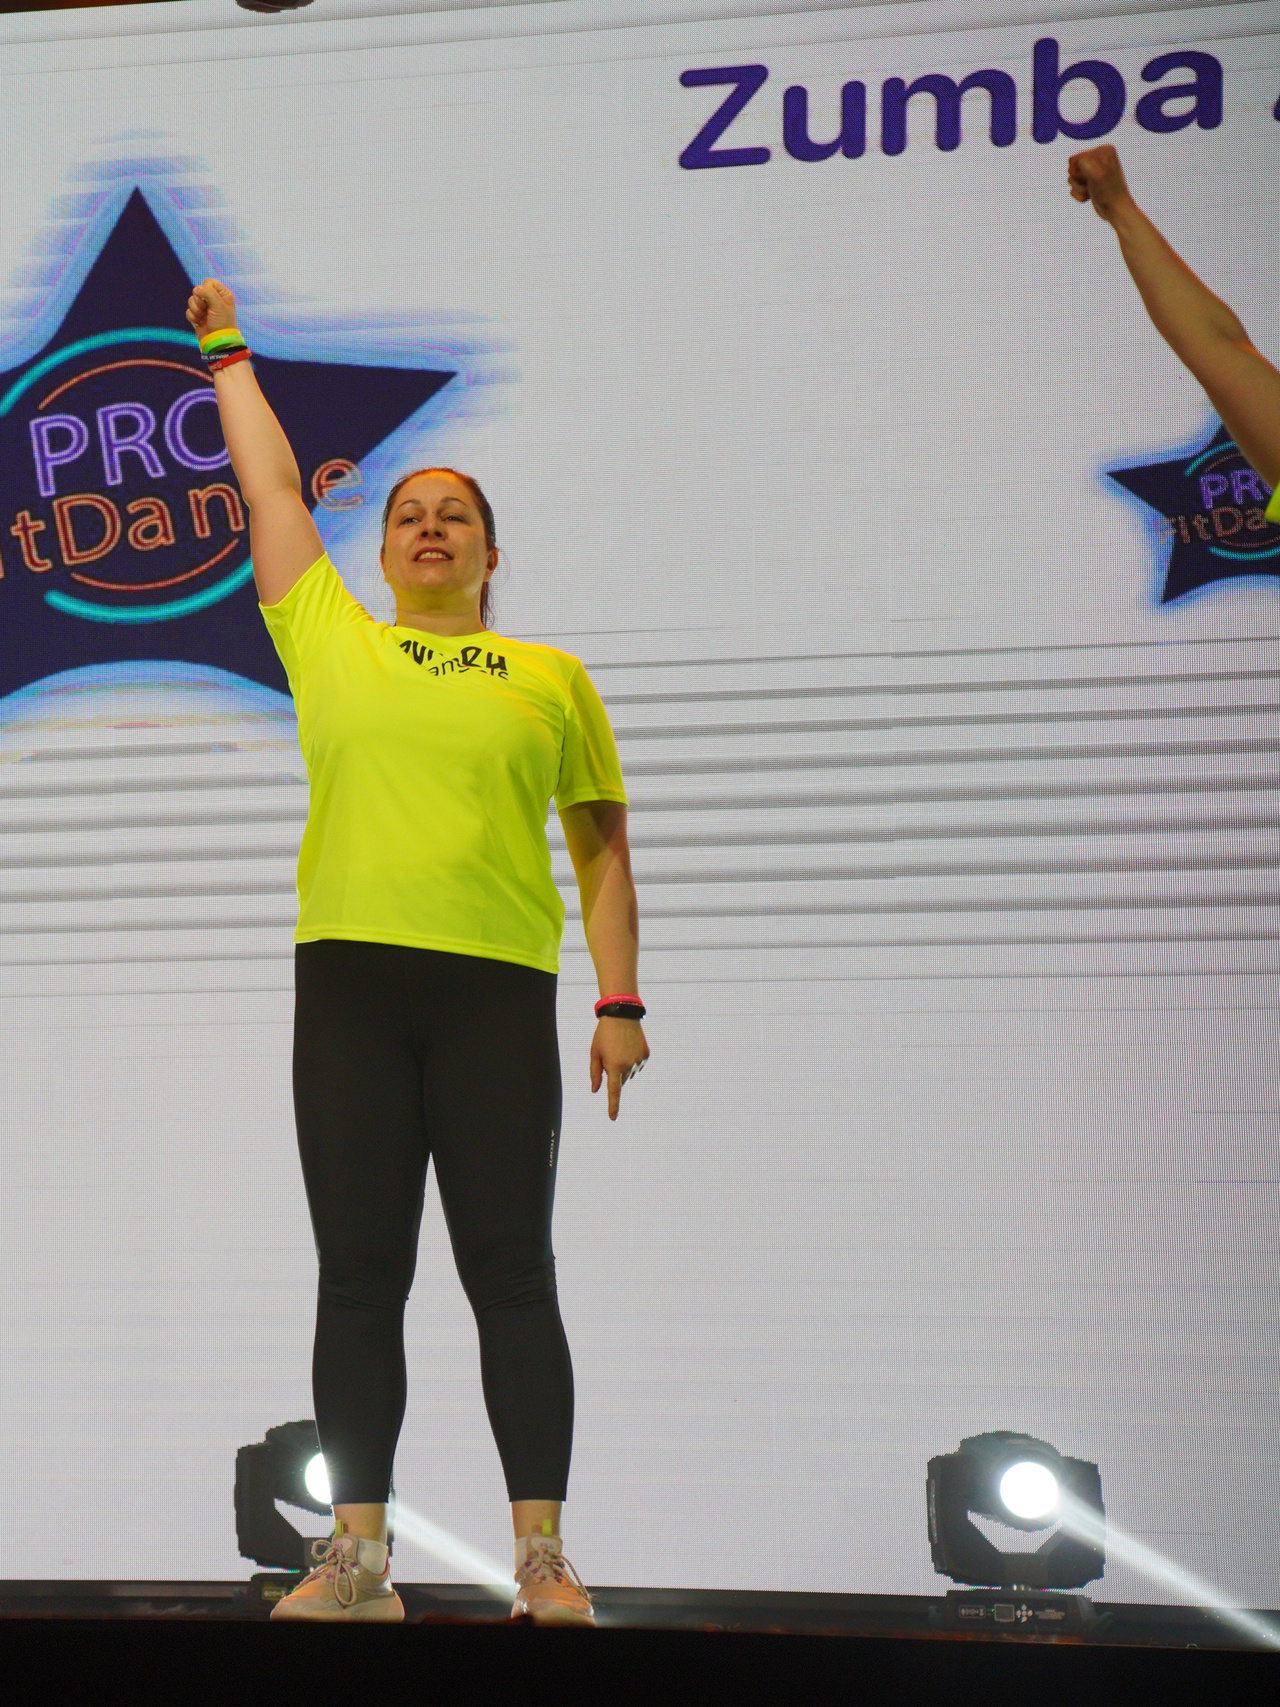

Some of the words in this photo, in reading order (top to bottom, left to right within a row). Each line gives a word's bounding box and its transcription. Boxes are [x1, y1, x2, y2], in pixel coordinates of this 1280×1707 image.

[678, 37, 1224, 170] Zumba
[28, 387, 231, 498] PRO
[1199, 468, 1274, 510] PR
